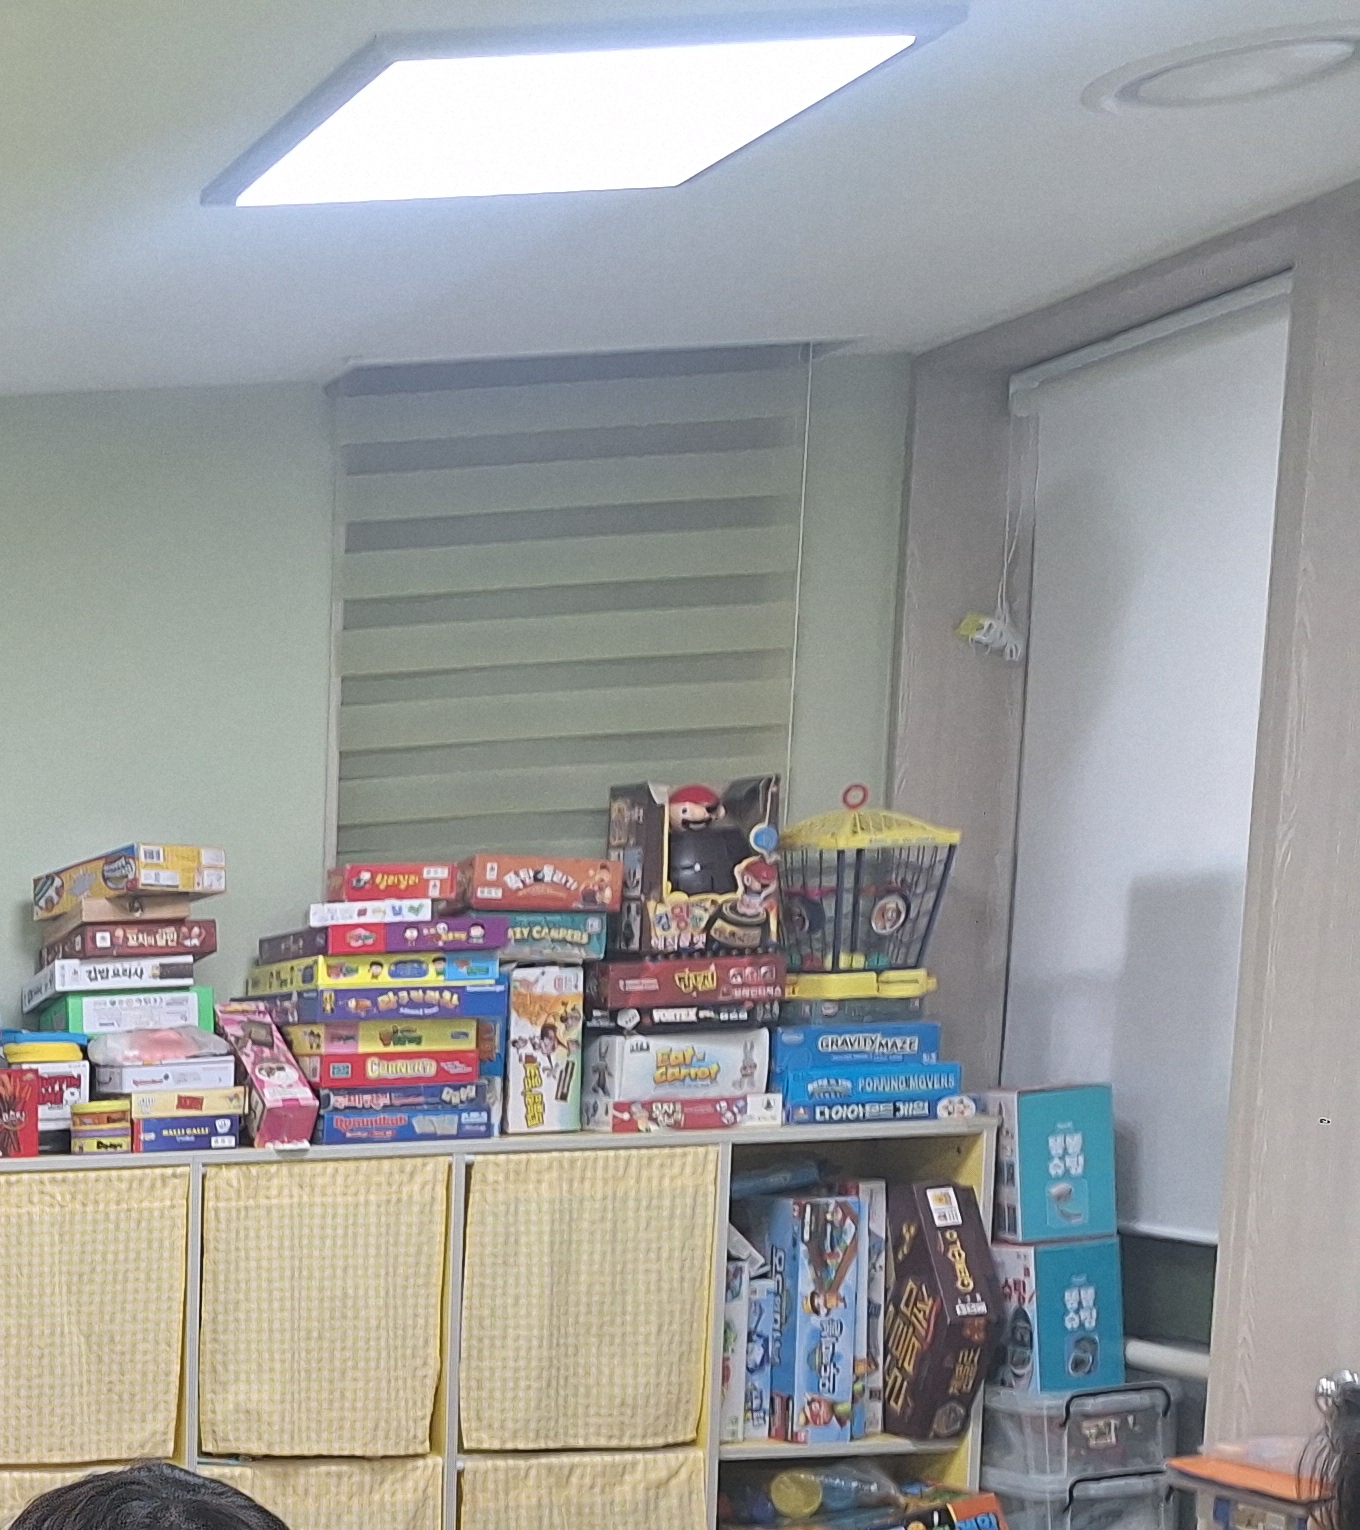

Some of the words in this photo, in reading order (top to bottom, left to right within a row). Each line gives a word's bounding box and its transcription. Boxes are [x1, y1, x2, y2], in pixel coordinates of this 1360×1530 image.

[818, 1034, 878, 1052] GRAVITY
[878, 1035, 919, 1054] MAZE
[653, 1062, 721, 1085] Carrot
[815, 1102, 894, 1122] 다이아몬드
